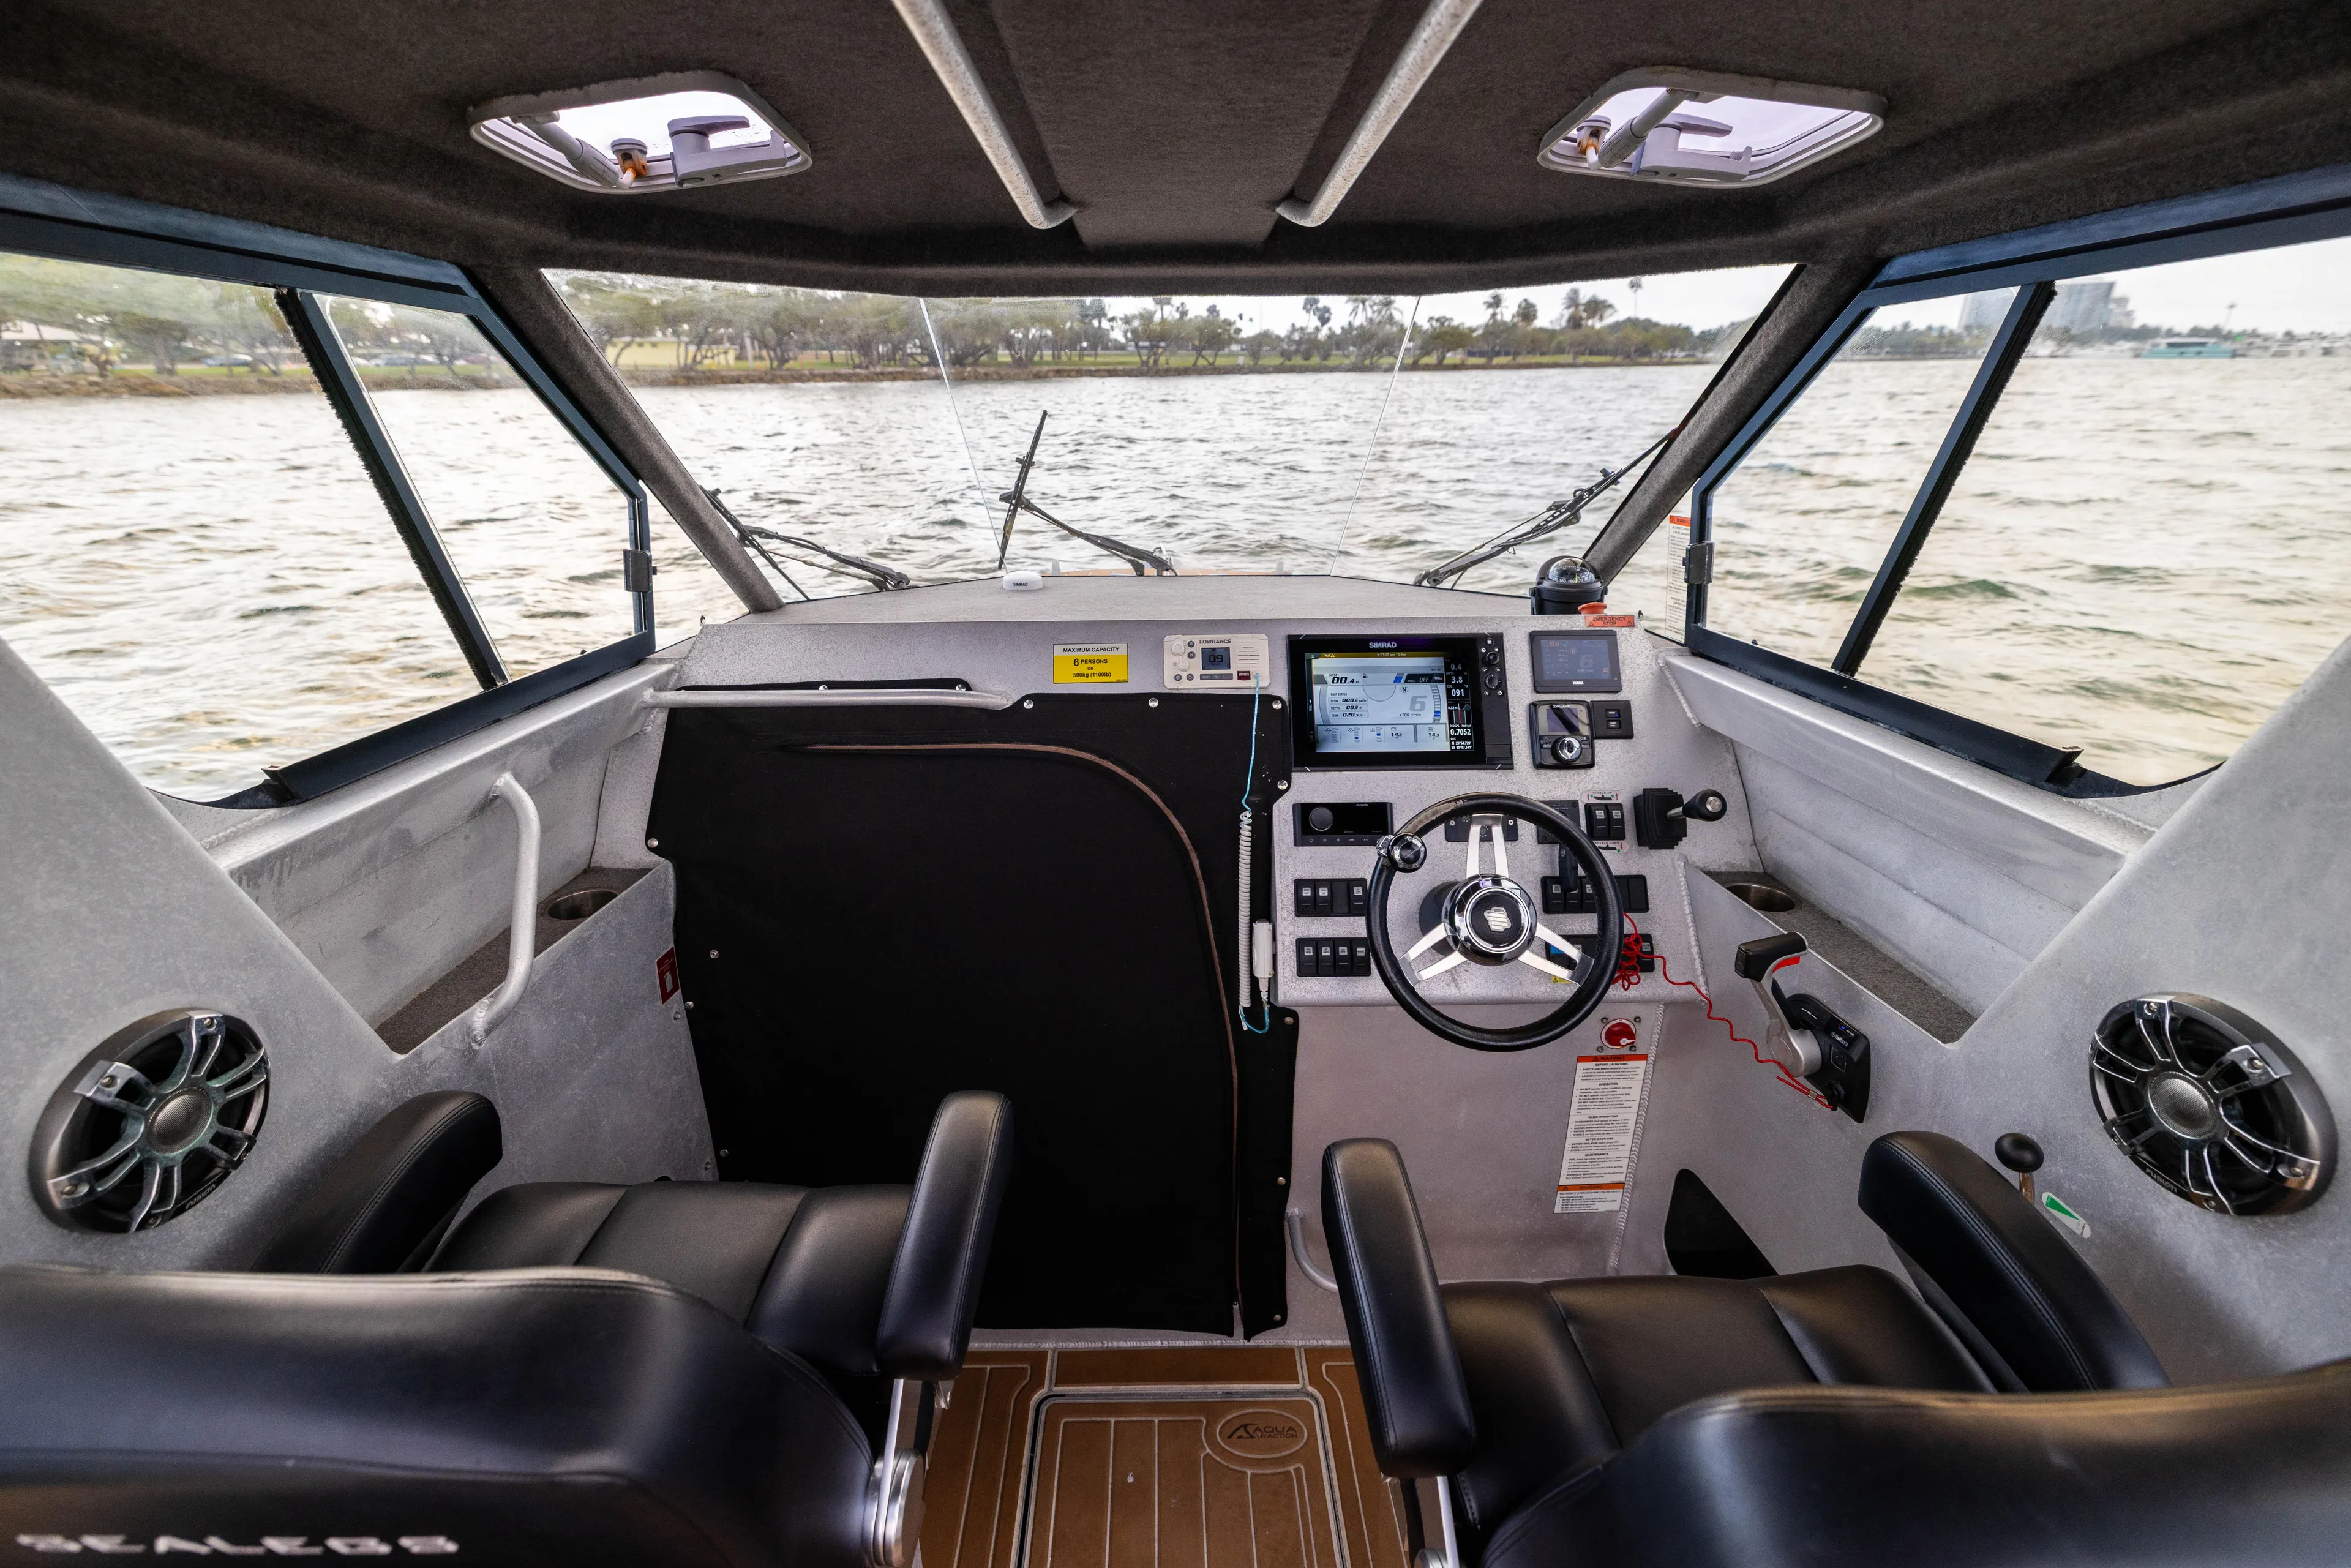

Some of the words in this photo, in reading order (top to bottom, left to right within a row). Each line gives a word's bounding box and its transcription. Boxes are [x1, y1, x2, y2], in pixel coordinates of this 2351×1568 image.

[1208, 655, 1223, 663] 09
[1409, 696, 1427, 711] 6
[1835, 1034, 1848, 1047] YAMAHA
